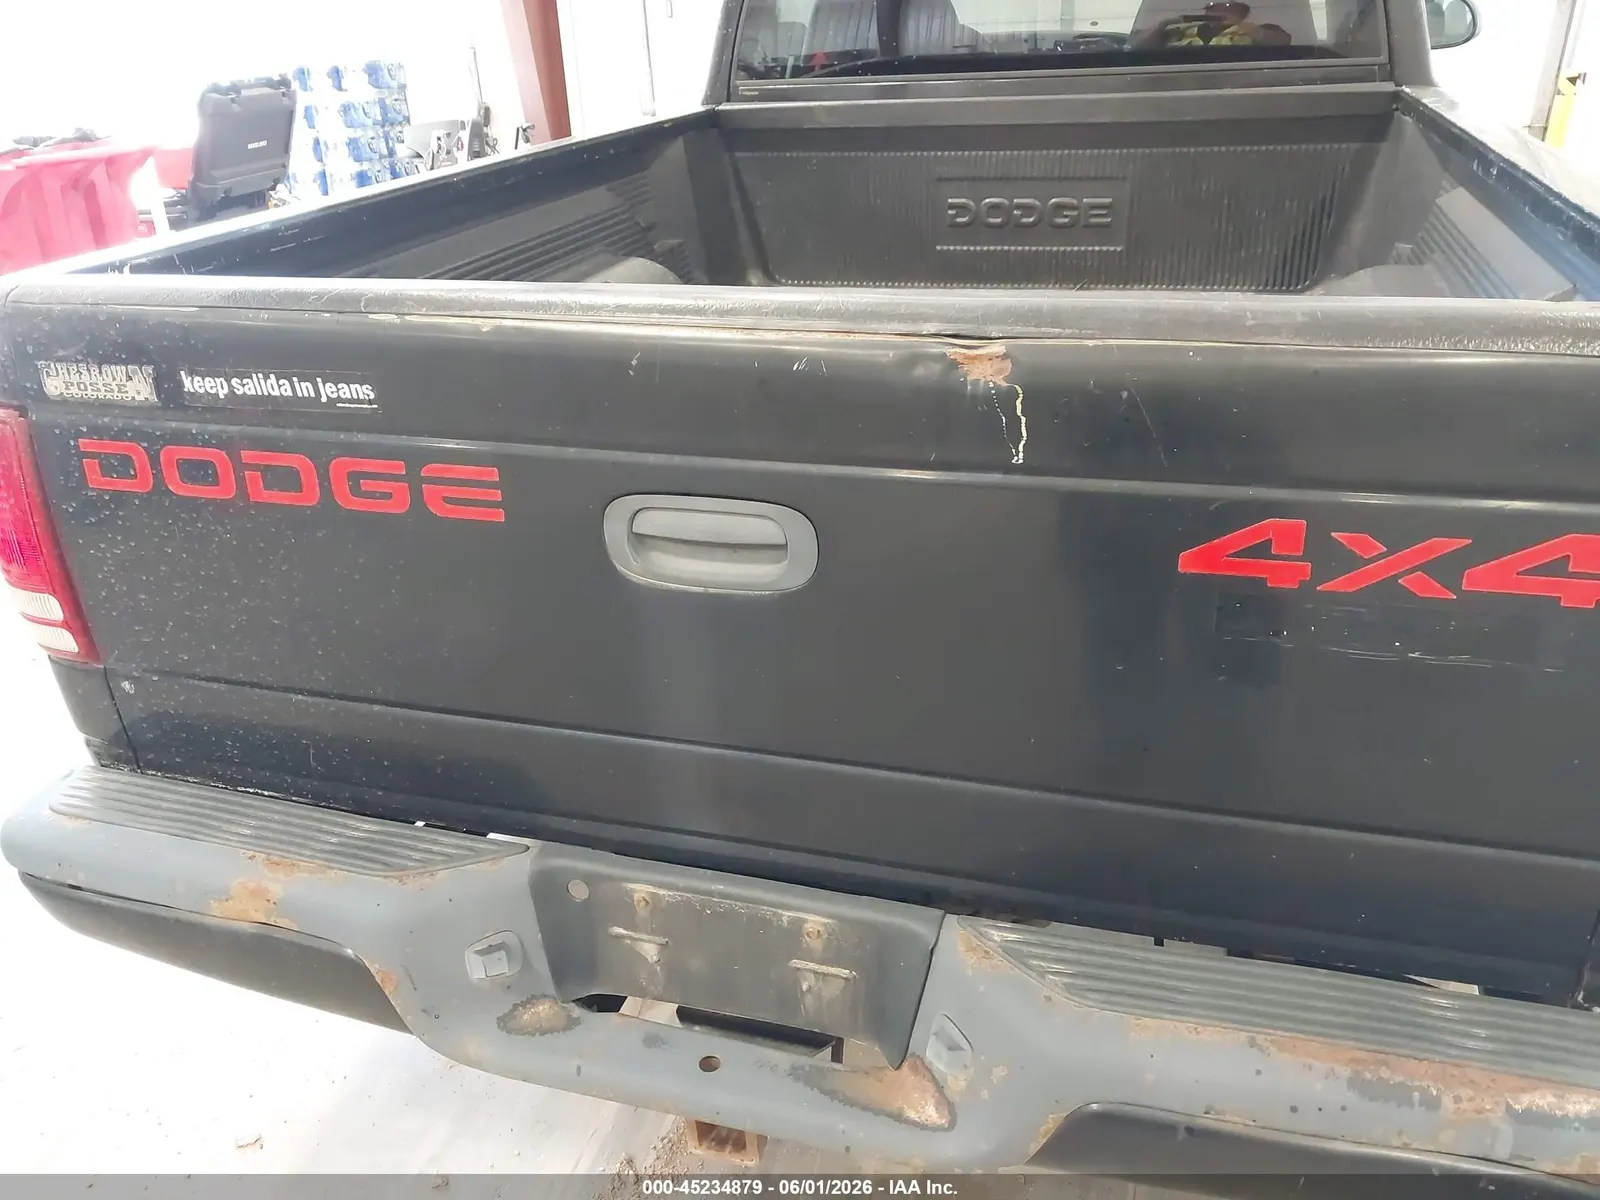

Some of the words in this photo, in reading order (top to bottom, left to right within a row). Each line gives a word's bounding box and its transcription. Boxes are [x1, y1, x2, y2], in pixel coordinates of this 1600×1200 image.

[946, 196, 1114, 229] DODGE
[62, 380, 129, 395] POSSE
[63, 391, 133, 401] COLORADO
[180, 370, 229, 399] keep
[231, 372, 293, 398] salida
[293, 376, 315, 398] in
[316, 377, 376, 403] jeans
[78, 438, 505, 523] DODGE
